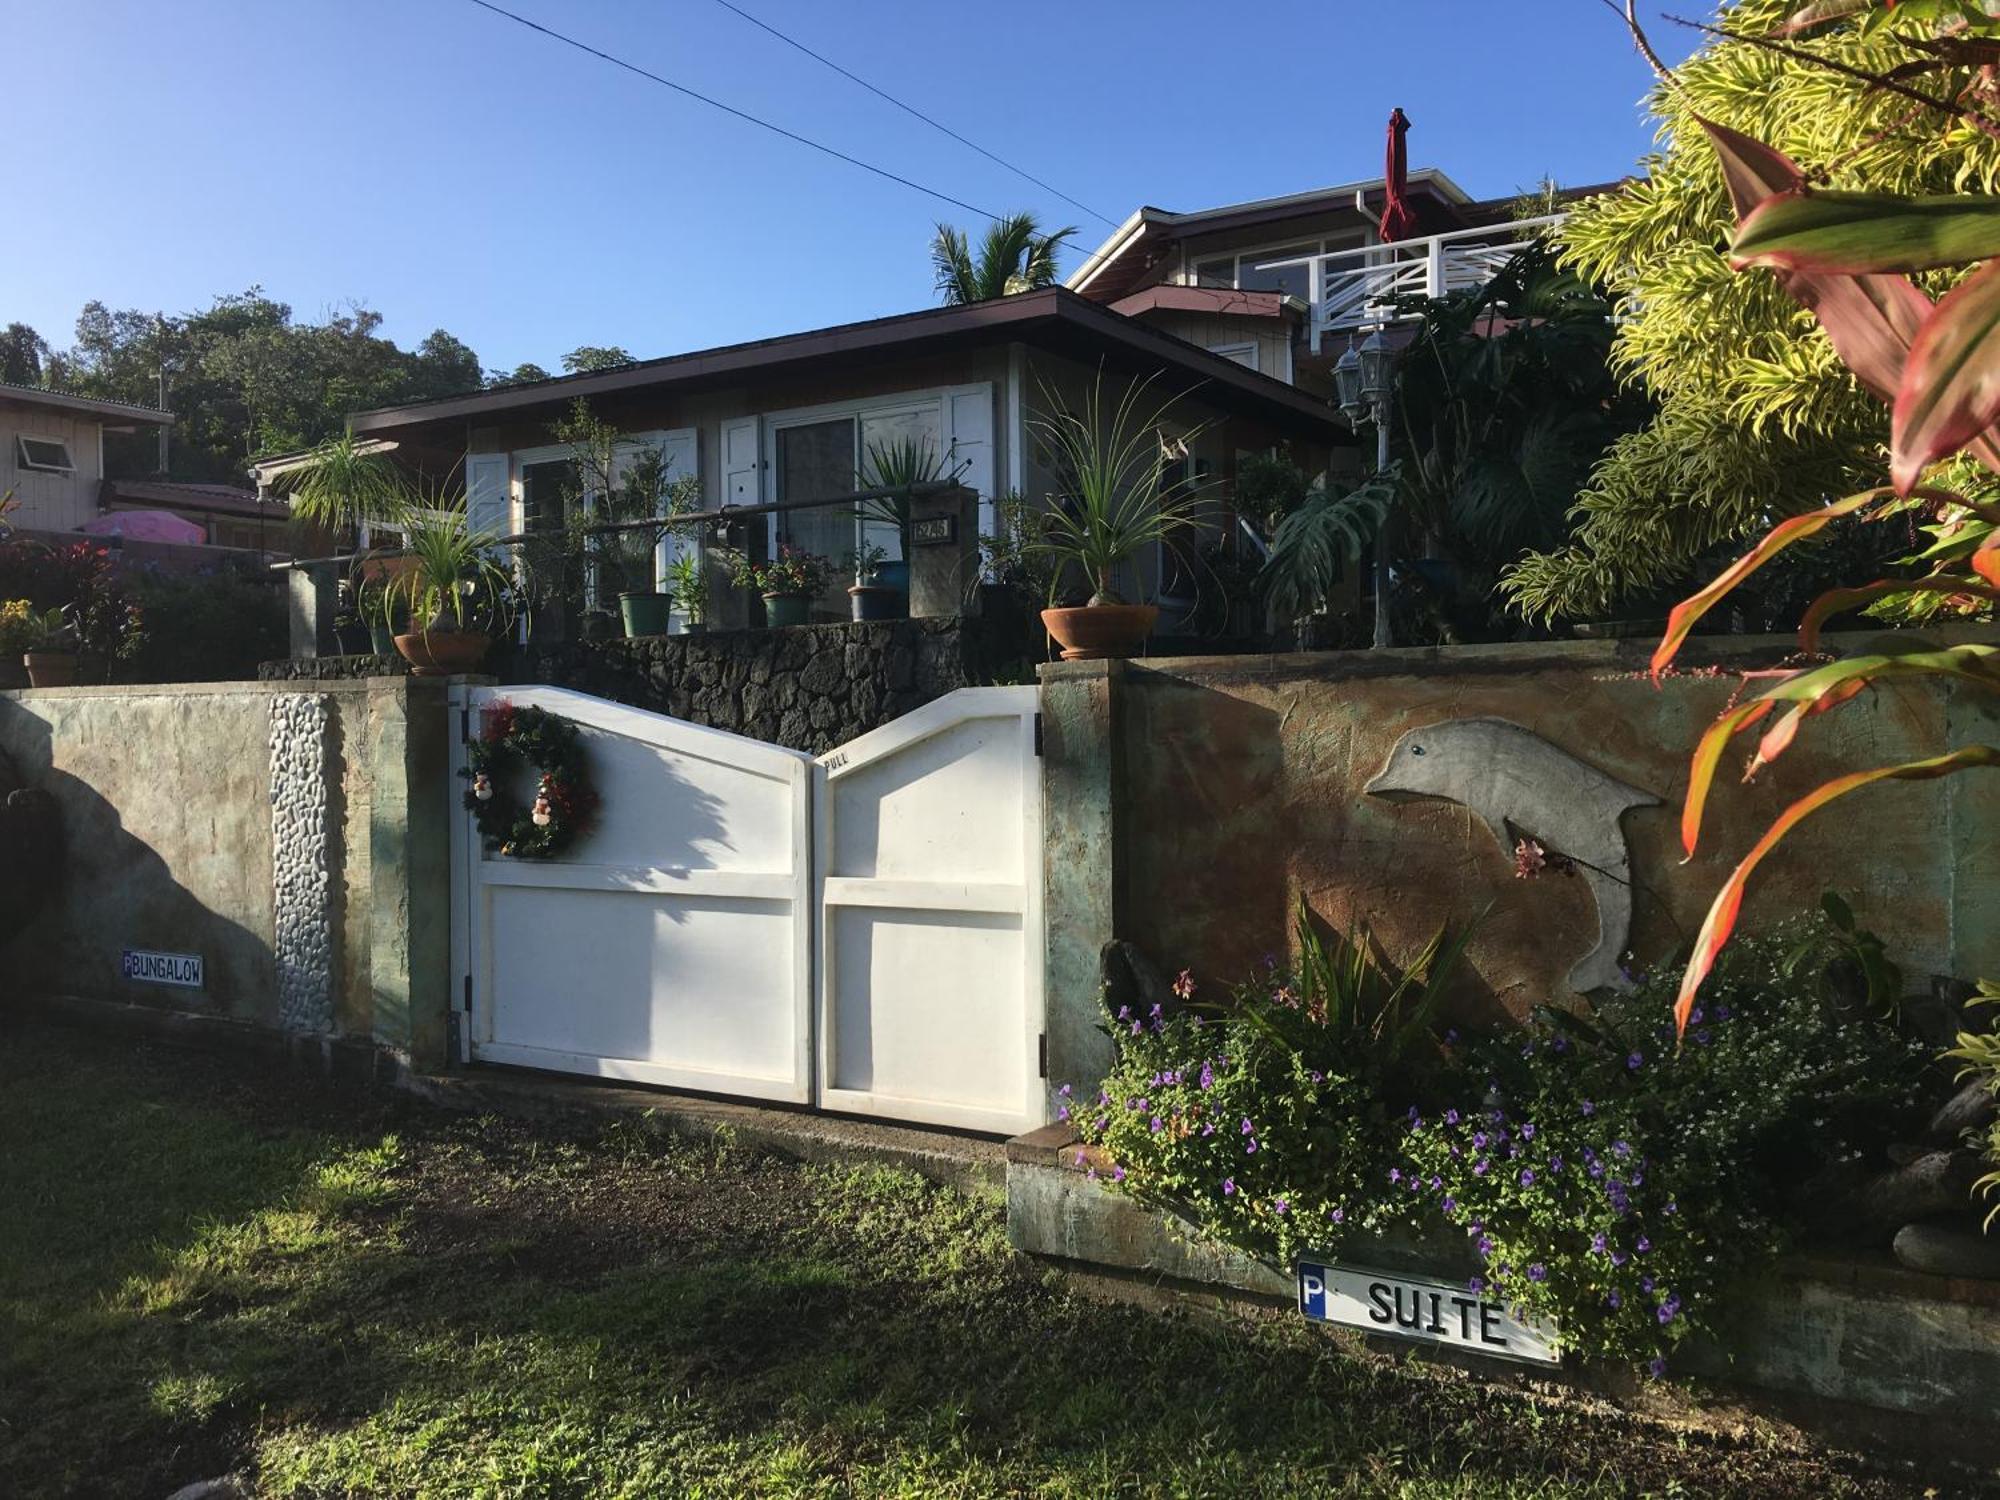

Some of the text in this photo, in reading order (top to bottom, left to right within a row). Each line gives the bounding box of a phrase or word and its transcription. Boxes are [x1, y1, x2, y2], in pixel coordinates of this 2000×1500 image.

[824, 753, 848, 773] PULL
[132, 956, 200, 982] BUNGALOW
[1303, 1274, 1508, 1346] P SUITE
